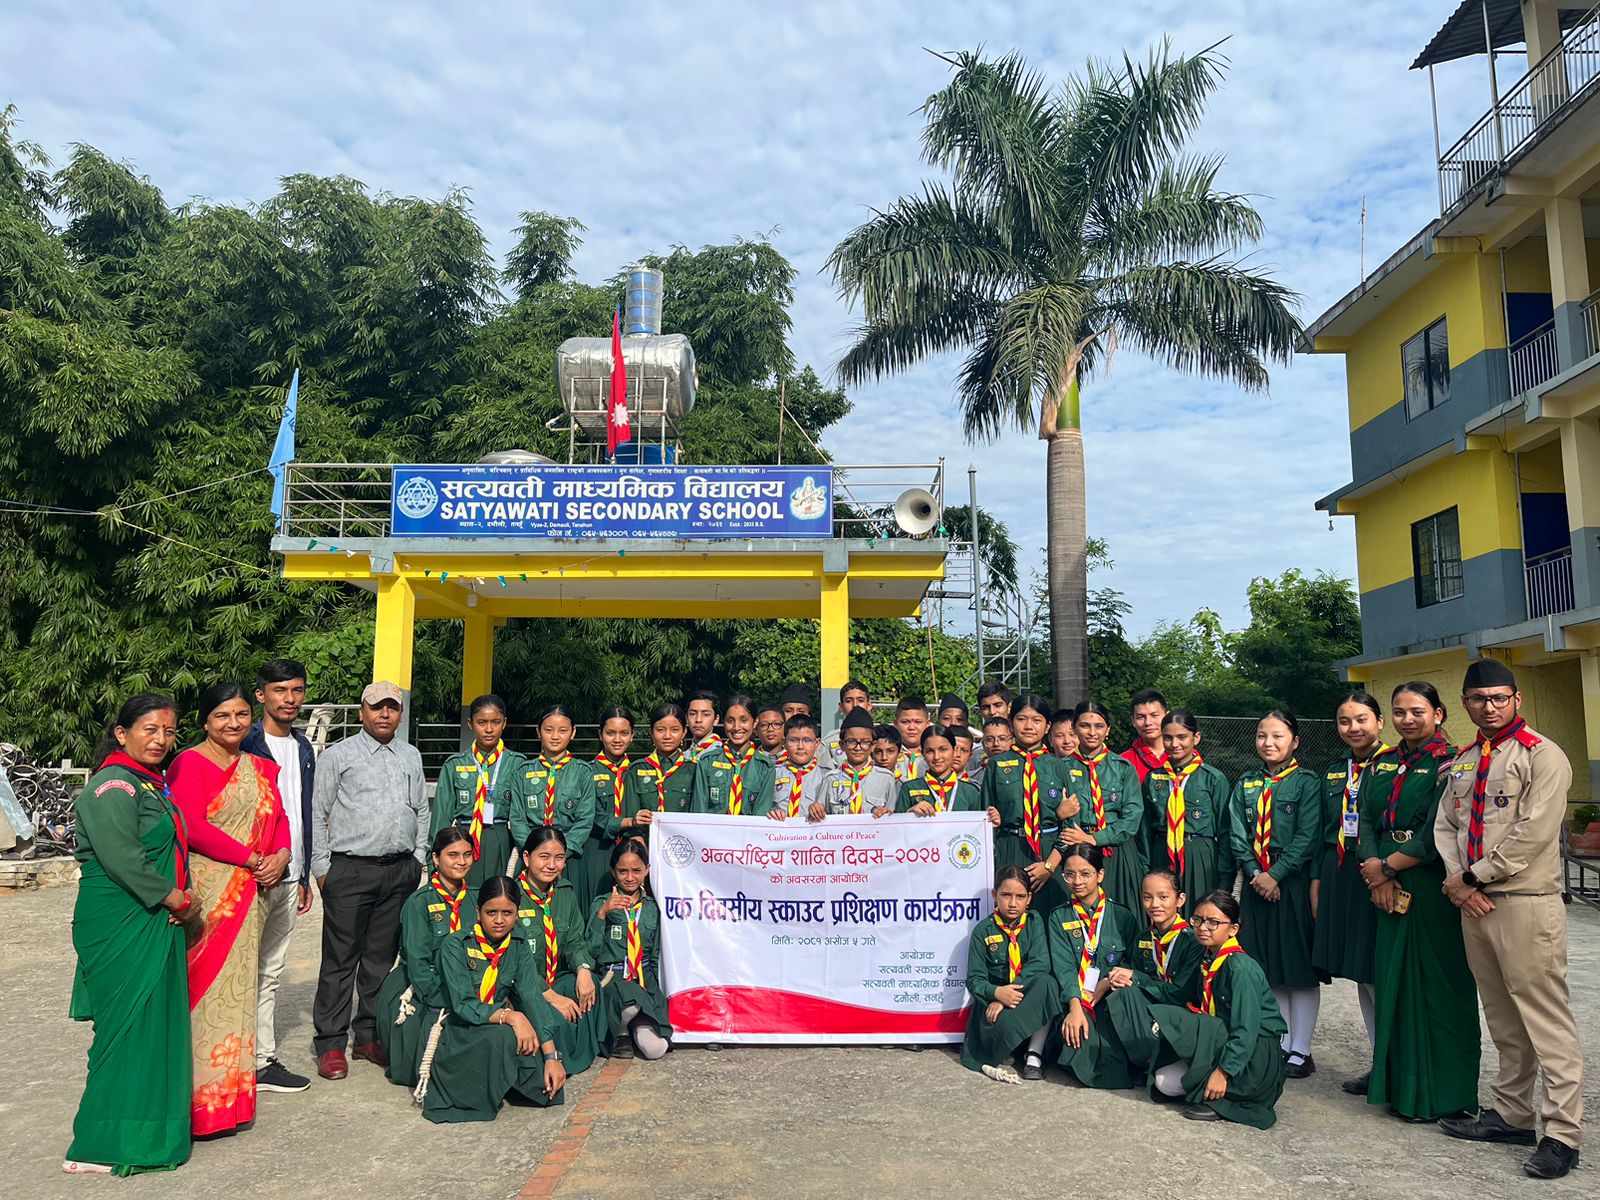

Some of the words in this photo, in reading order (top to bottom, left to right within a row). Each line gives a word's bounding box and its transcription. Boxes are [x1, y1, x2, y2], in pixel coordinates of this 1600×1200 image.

[440, 476, 545, 499] सत्यवती
[552, 476, 676, 498] माध्यमिक
[684, 476, 785, 499] विद्यालय
[440, 502, 559, 520] SATYAWATI
[565, 502, 693, 520] SECONDARY
[698, 502, 785, 520] SCHOOL
[815, 831, 844, 841] Culture
[790, 846, 835, 866] शान्ति
[665, 896, 693, 920] एक
[699, 889, 762, 923] दिवसीय
[768, 900, 825, 924] स्काउट
[831, 892, 898, 925] प्रशिक्षण
[904, 892, 981, 923] कार्यक्रम
